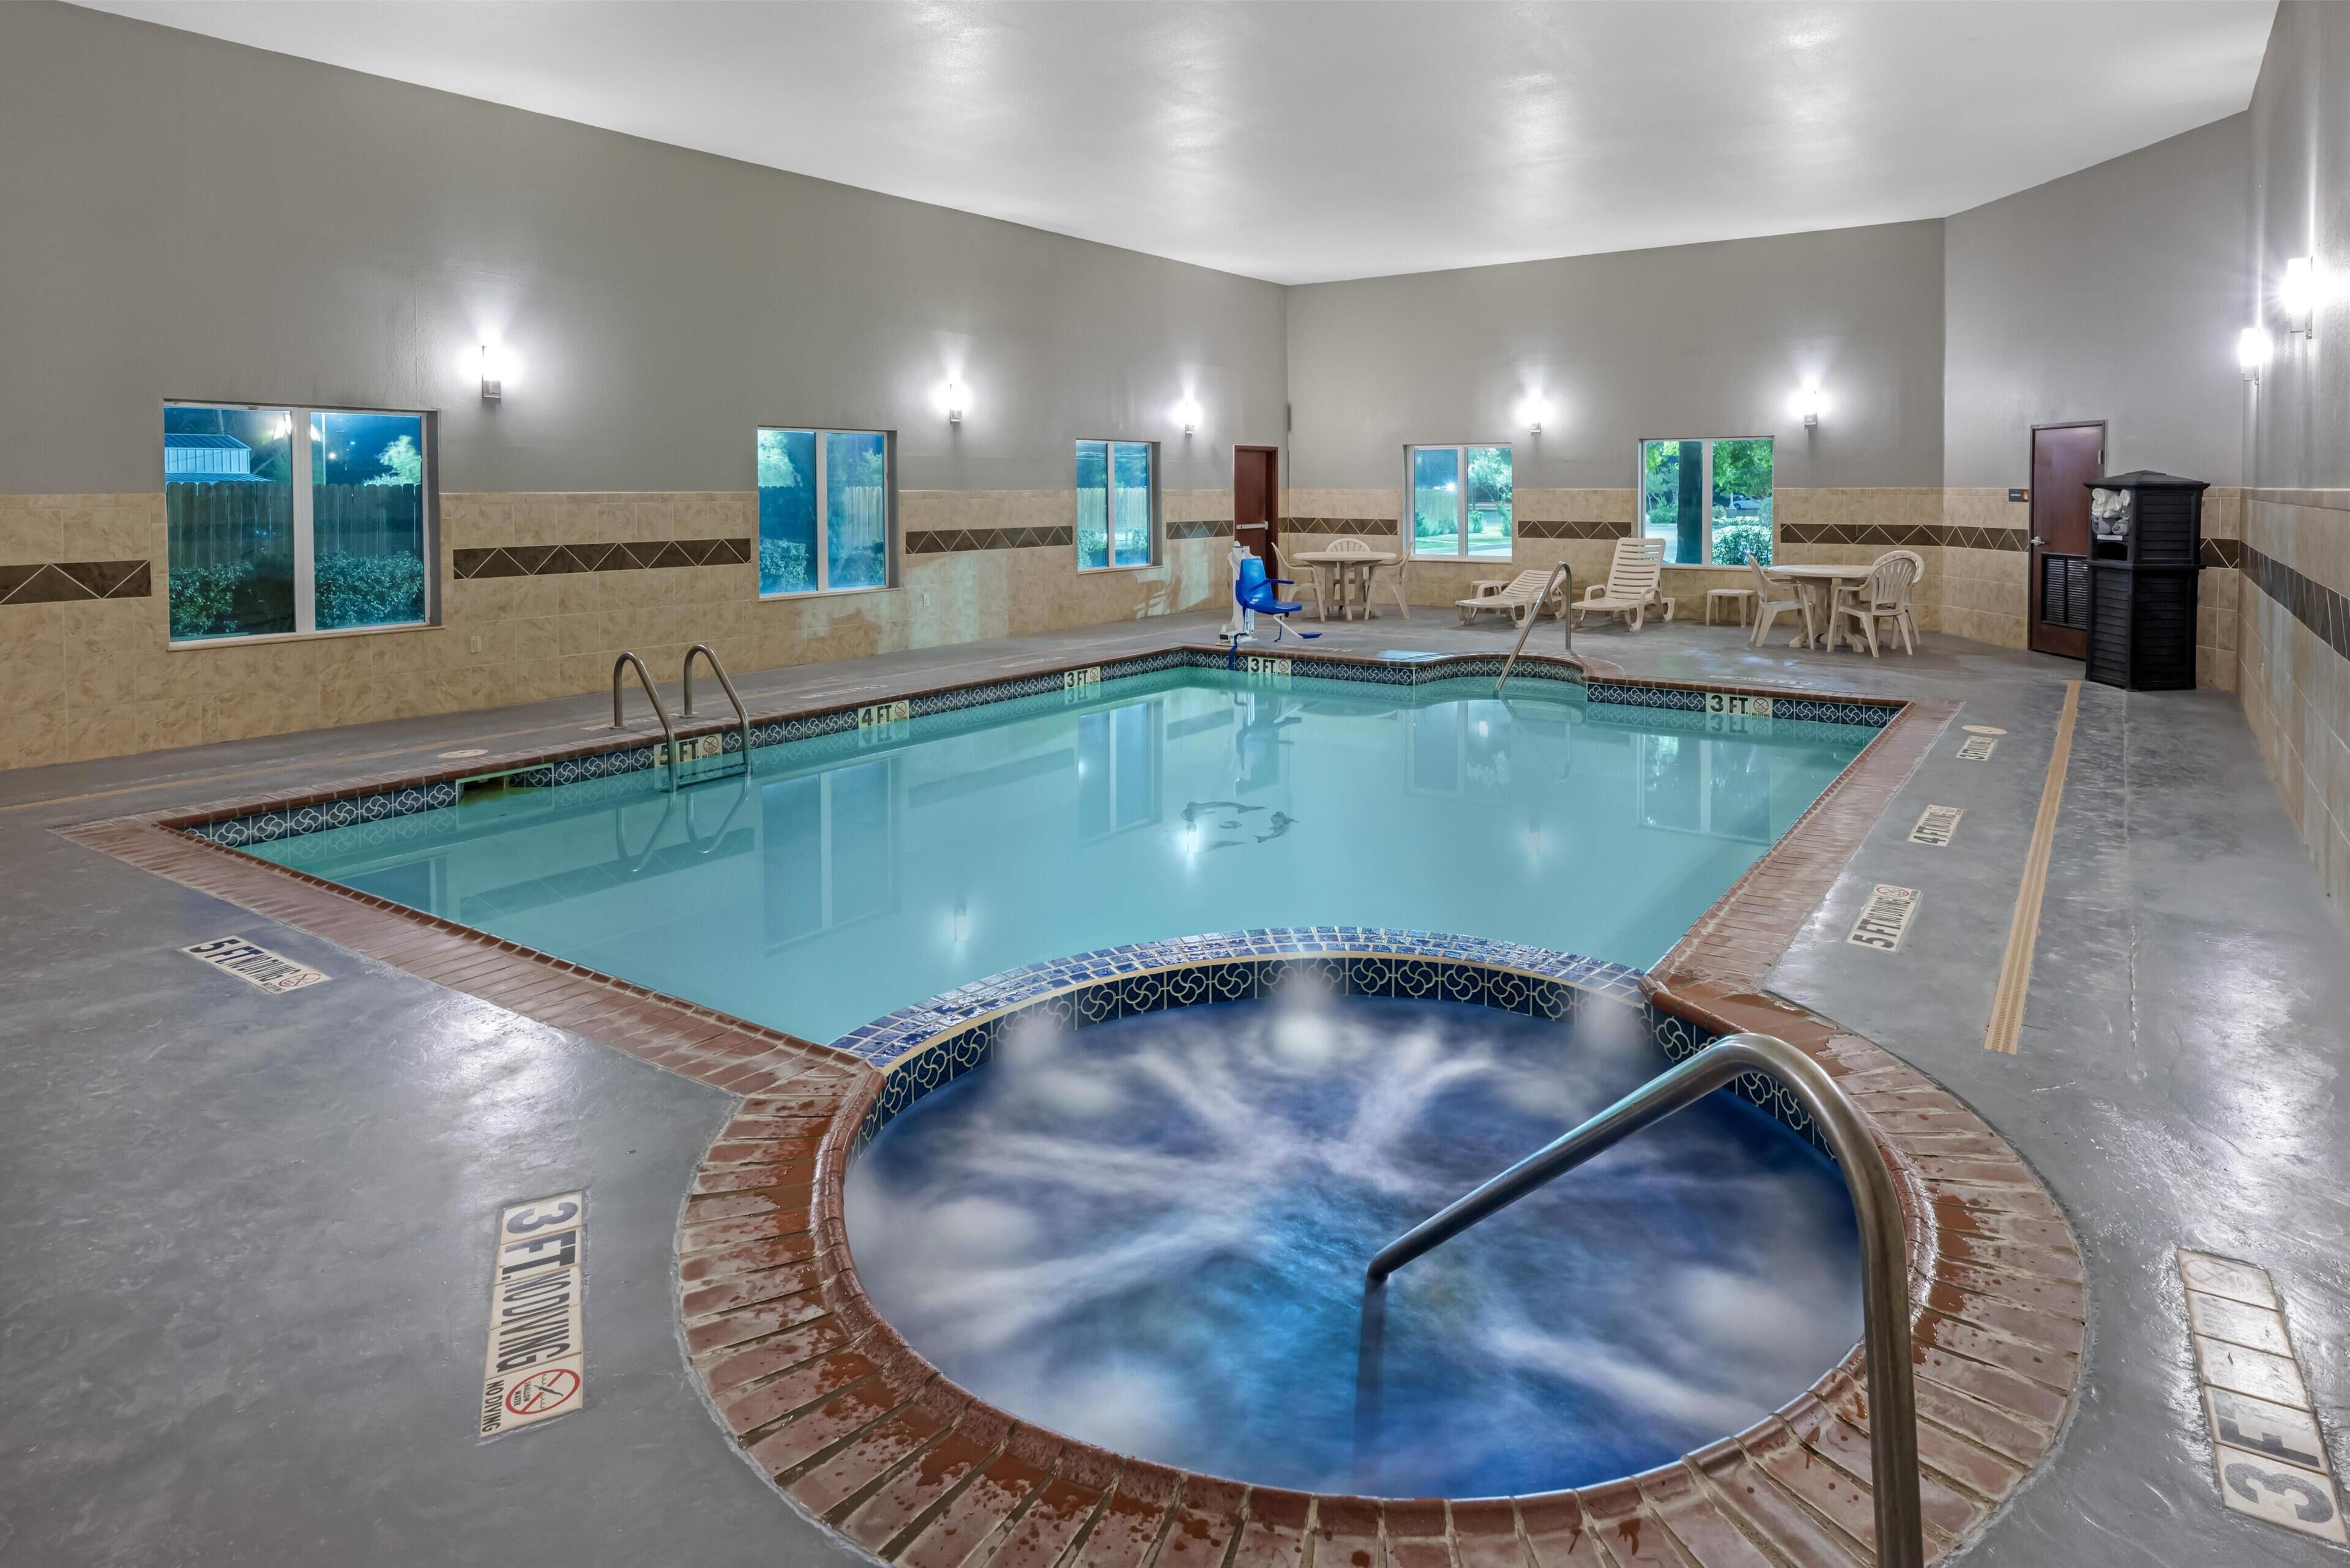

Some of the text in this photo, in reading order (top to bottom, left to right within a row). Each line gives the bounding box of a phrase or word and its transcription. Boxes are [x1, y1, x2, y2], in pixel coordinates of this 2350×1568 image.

[1250, 658, 1275, 674] 3 FT.
[1067, 670, 1088, 687] 3 FT.
[1710, 695, 1748, 715] 3 FT.
[861, 704, 892, 726] 4 FT.
[679, 739, 699, 762] FT.
[1913, 835, 1946, 844] 4
[1856, 918, 1902, 937] FT.
[188, 938, 241, 953] 5
[1852, 934, 1895, 949] 5
[204, 946, 264, 965] FT.
[225, 954, 273, 969] NO
[496, 1202, 578, 1373] 3 FT. NO DIVING
[482, 1379, 504, 1432] NO DIVING
[2225, 1462, 2334, 1523] 3
